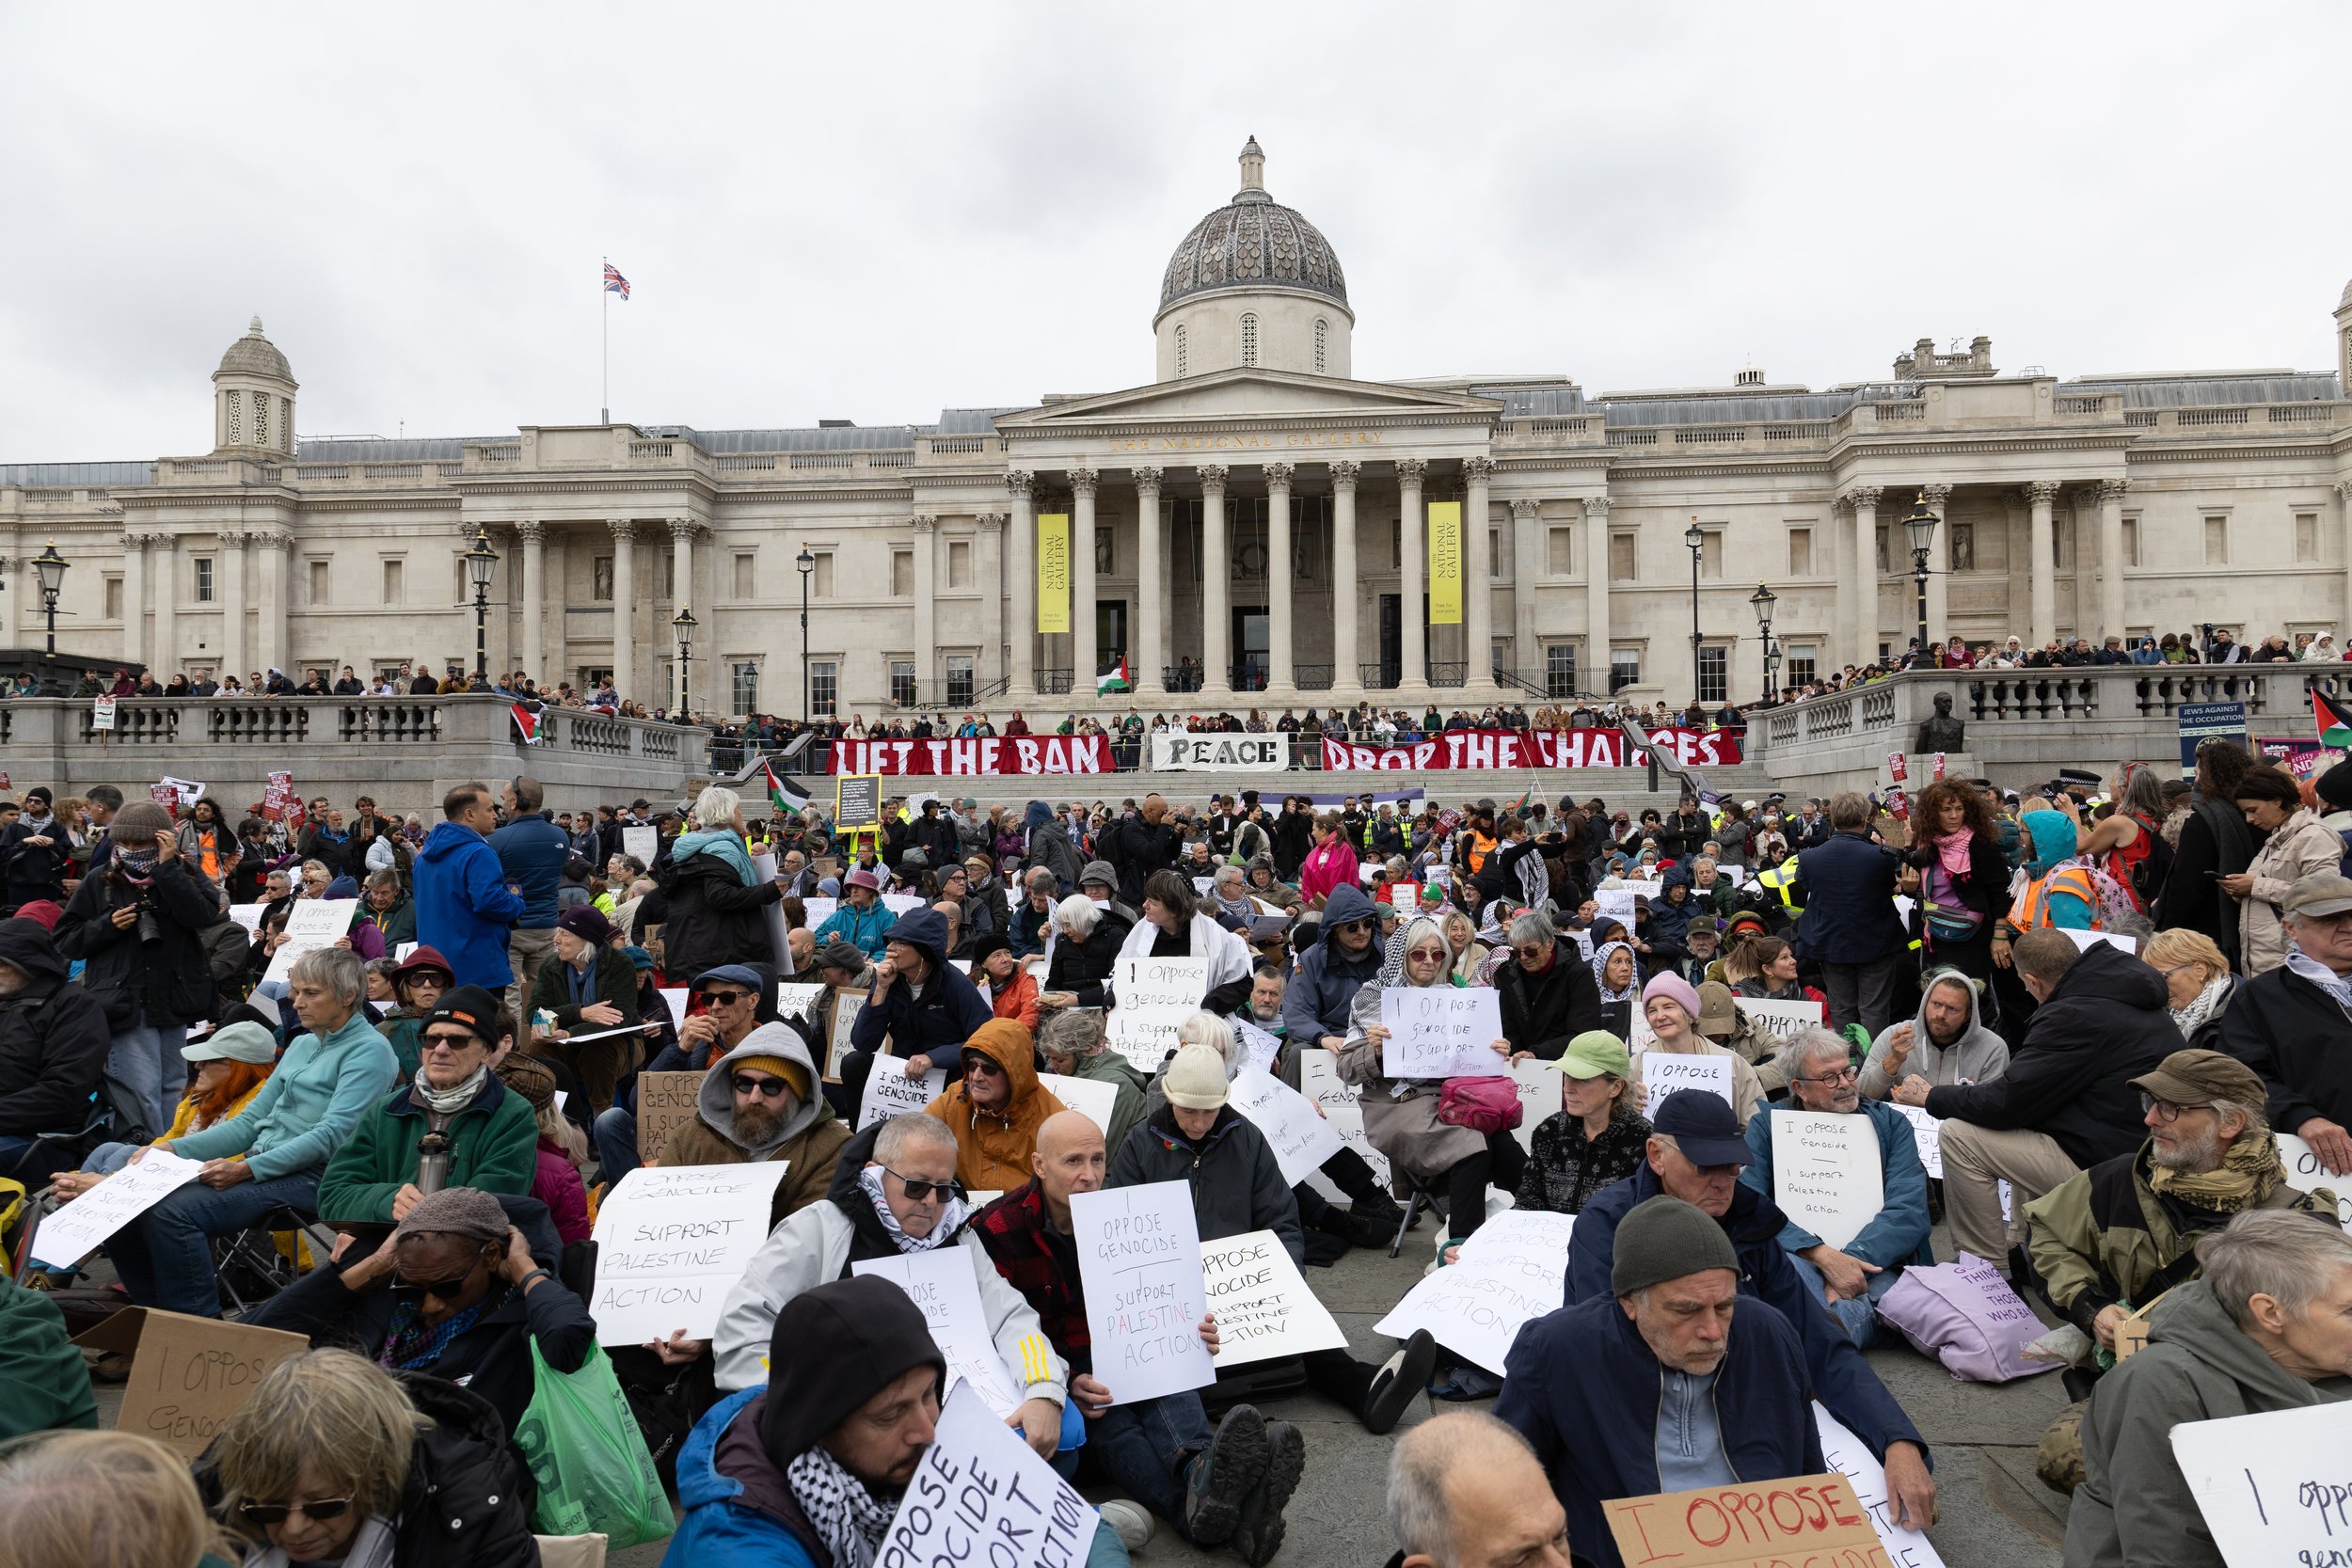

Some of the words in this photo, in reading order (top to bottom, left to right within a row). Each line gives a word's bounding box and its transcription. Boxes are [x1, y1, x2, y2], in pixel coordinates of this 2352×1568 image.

[1109, 438, 1150, 451] THE
[1164, 435, 1273, 451] NATIONAL
[1285, 431, 1384, 447] GALLERY
[1438, 522, 1446, 578] NATIONAL
[1446, 522, 1456, 578] GALLERY
[1046, 533, 1055, 590] NATIONAL
[1055, 534, 1065, 591] GALLERY
[2184, 707, 2203, 716] JEWS
[2204, 705, 2238, 714] AGAINST
[2195, 715, 2245, 724] OCCUPATION
[836, 740, 914, 775] LIFT
[927, 738, 1000, 775] THE
[1014, 736, 1100, 774] BAN
[1169, 738, 1277, 766] PEACE
[1324, 736, 1437, 770] DROP
[1445, 735, 1518, 769] THE
[307, 907, 342, 918] OPPOSE
[1131, 961, 1136, 984] I
[1397, 997, 1401, 1019] I
[1137, 1022, 1178, 1038] suppor
[1402, 1045, 1406, 1062] I
[879, 1071, 887, 1081] I
[891, 1075, 930, 1091] OPPOSE
[1311, 1065, 1325, 1079] I
[1653, 1064, 1657, 1077] I
[1663, 1064, 1720, 1079] OPPOSE
[644, 1075, 653, 1093] I
[662, 1074, 704, 1092] OPPO
[877, 1085, 929, 1104] GENOCIDE
[644, 1114, 652, 1130] I
[869, 1108, 878, 1118] I
[1785, 1120, 1794, 1133] I
[1804, 1122, 1848, 1134] OPPOSE
[1801, 1137, 1849, 1150] Genocide
[644, 1170, 733, 1186] OPPOSE
[1800, 1170, 1844, 1180] support
[628, 1182, 754, 1200] GENOCIDE
[1788, 1182, 1837, 1197] Palestine
[1126, 1191, 1130, 1213] I
[609, 1224, 614, 1248] I
[634, 1219, 744, 1243] SUPPORT
[1104, 1213, 1163, 1241] OPPOSE
[1510, 1217, 1573, 1234] OPPOS
[1098, 1235, 1178, 1263] GENOCIDE
[1202, 1243, 1270, 1275] PPOSE
[603, 1246, 728, 1274] PALESTINE
[907, 1259, 911, 1280] I
[1962, 1266, 2002, 1286] THING
[1115, 1283, 1176, 1312] SUPPORT
[1447, 1274, 1552, 1319] PALESTINE
[1981, 1283, 2000, 1295] COME
[2000, 1281, 2009, 1292] TO
[598, 1288, 702, 1310] ACTION
[1107, 1302, 1194, 1338] PALESTINE
[1215, 1307, 1294, 1326] LESTINE
[1415, 1292, 1521, 1337] ACTION
[1987, 1308, 2018, 1323] WHO
[1125, 1332, 1201, 1370] ACTION
[158, 1347, 168, 1392] I
[183, 1350, 265, 1393] OPPOS
[2243, 1467, 2268, 1527] I
[1617, 1502, 1685, 1565] I
[1686, 1483, 1863, 1546] OPPOSE
